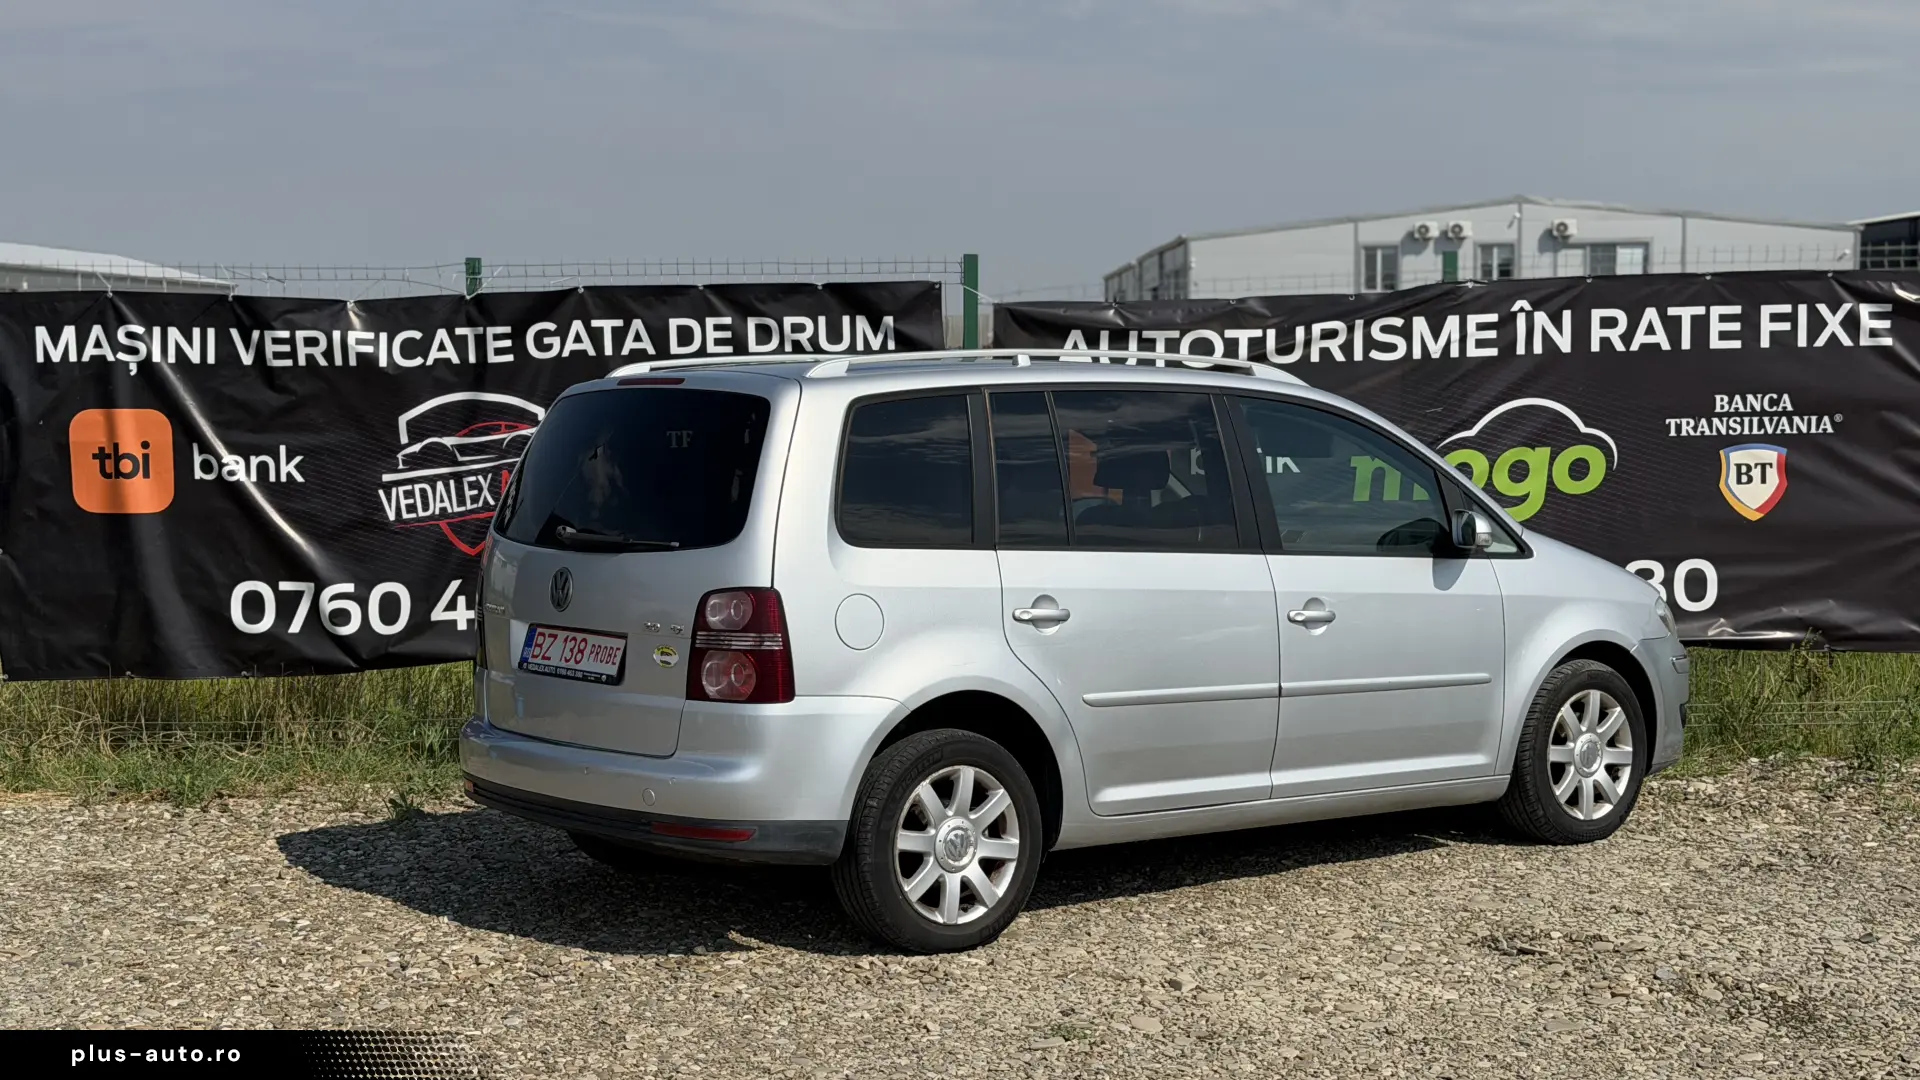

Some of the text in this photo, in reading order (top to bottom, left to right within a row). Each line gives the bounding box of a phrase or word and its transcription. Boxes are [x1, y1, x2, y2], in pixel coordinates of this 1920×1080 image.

[35, 315, 896, 376] MAȘINI VERIFICATE GATA DE DRUM
[1059, 300, 1894, 368] AUTOTURISME ÎN RATE FIXE
[1714, 393, 1794, 413] BANCA
[666, 430, 693, 448] TF
[92, 440, 305, 483] tbi bank
[1733, 462, 1773, 486] BT
[378, 473, 496, 522] VEDALEX
[230, 580, 411, 636] 0760
[531, 631, 559, 661] BZ
[560, 635, 588, 665] 138
[587, 643, 621, 666] PROBE
